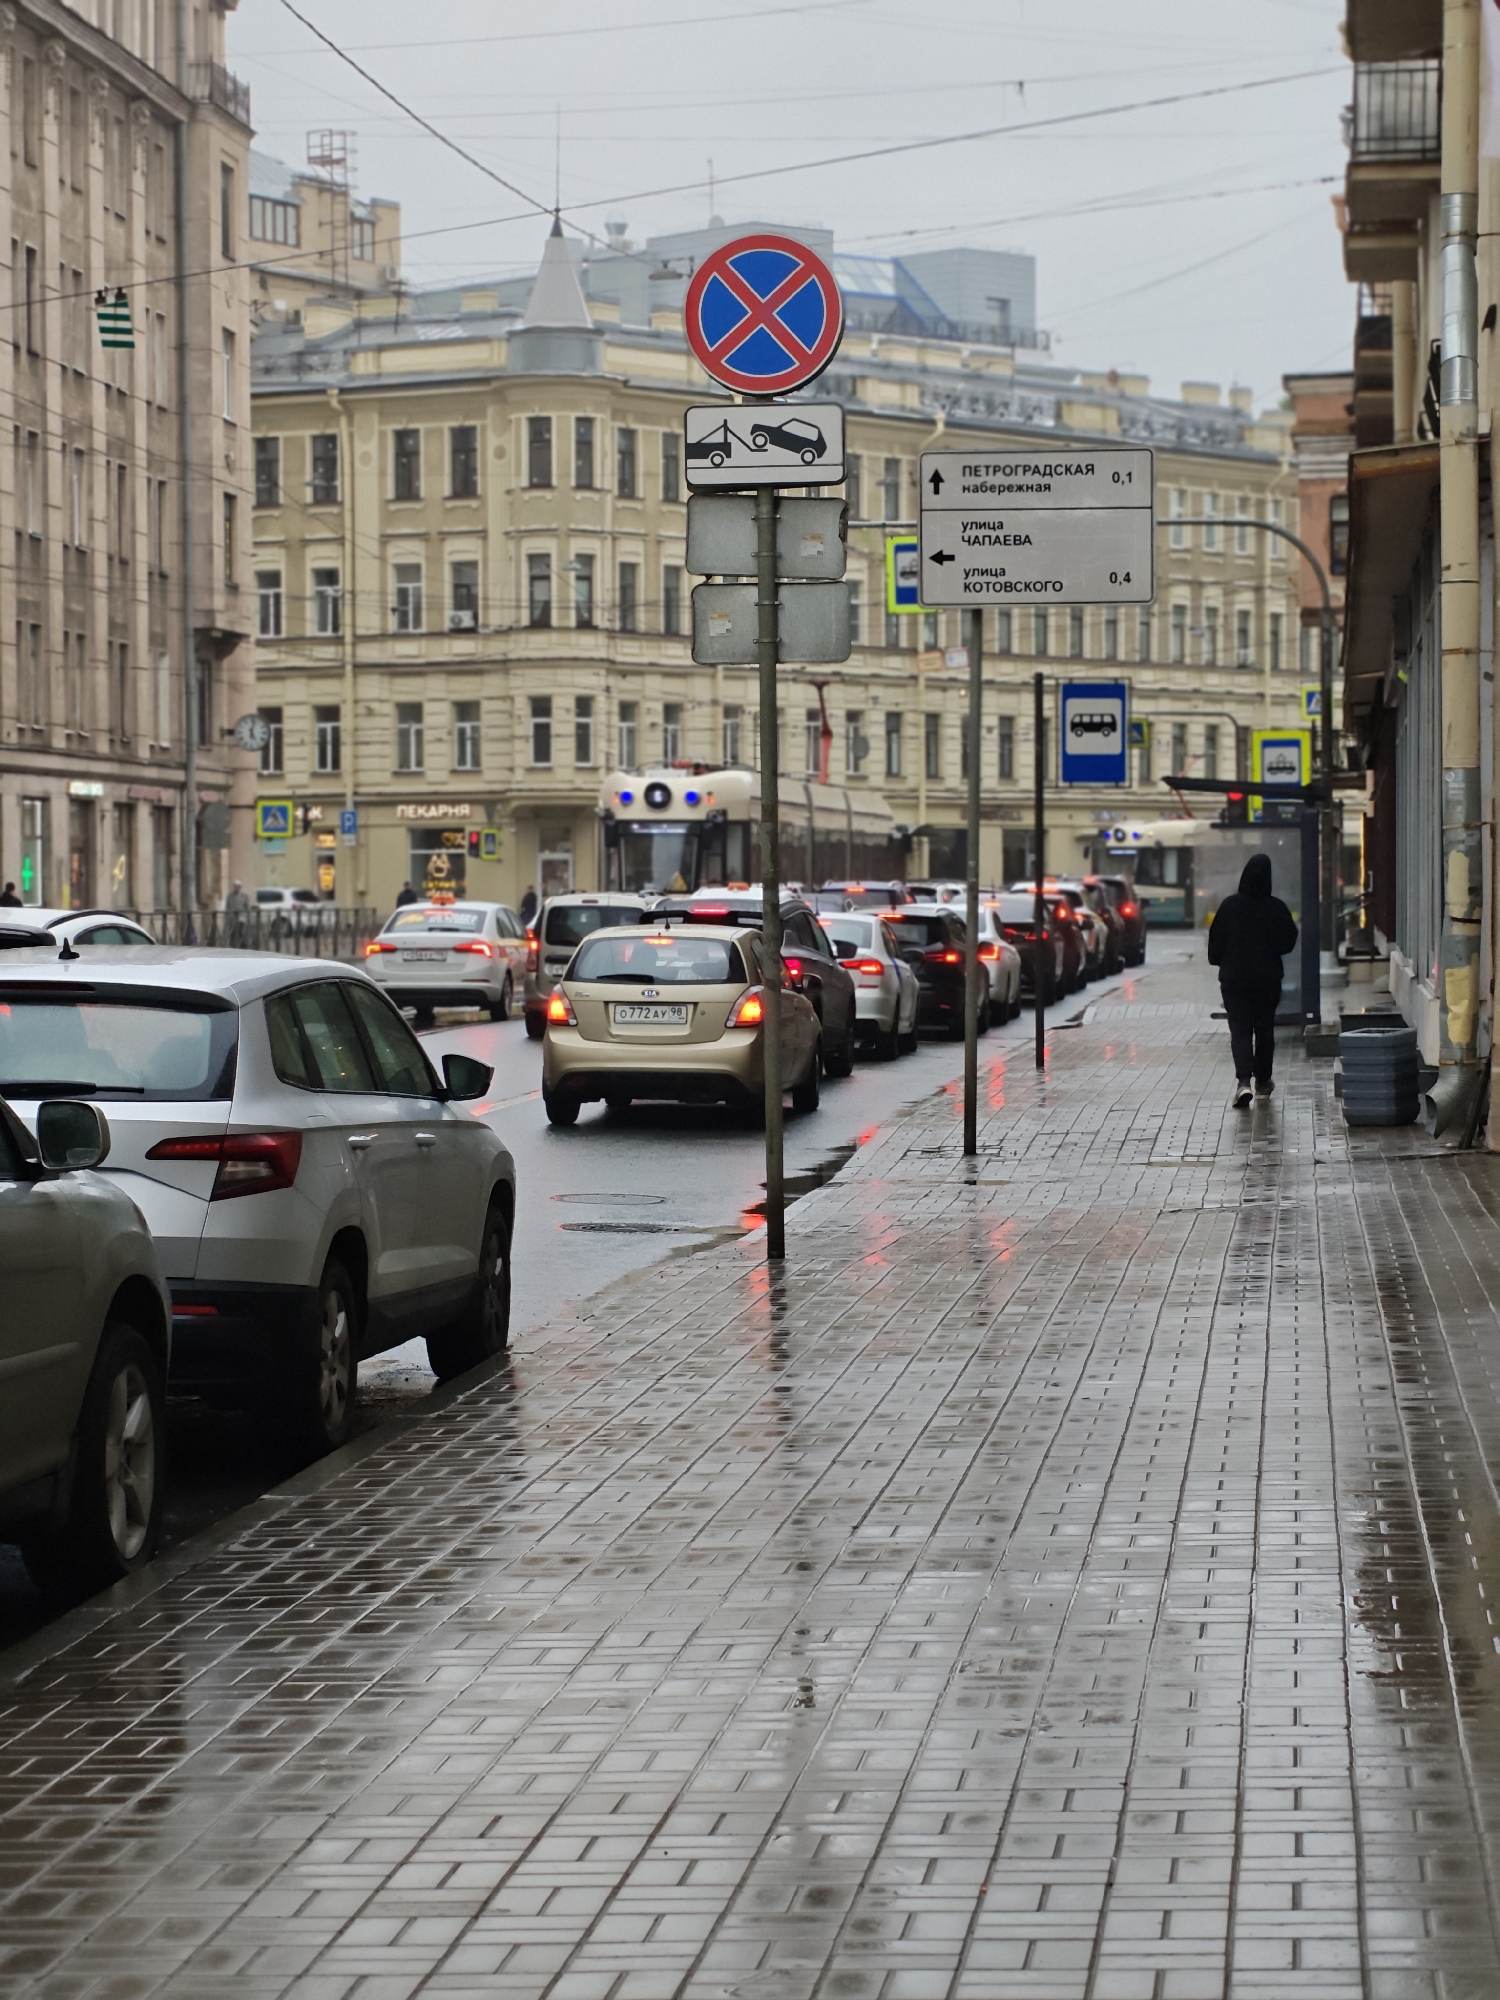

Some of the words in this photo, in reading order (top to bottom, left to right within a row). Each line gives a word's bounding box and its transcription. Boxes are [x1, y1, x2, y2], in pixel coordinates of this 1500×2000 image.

[962, 463, 1095, 478] ПЕТРОГРАДСКАЯ
[1111, 471, 1133, 486] 0,1
[962, 482, 1052, 495] набережная
[961, 520, 1004, 533] улица
[961, 534, 1032, 546] ЧАПАЕВА
[963, 567, 1006, 580] улица
[1109, 571, 1132, 586] 0,4
[963, 580, 1064, 593] КОТОВСКОГО
[396, 803, 471, 818] ПЕКАРНЯ
